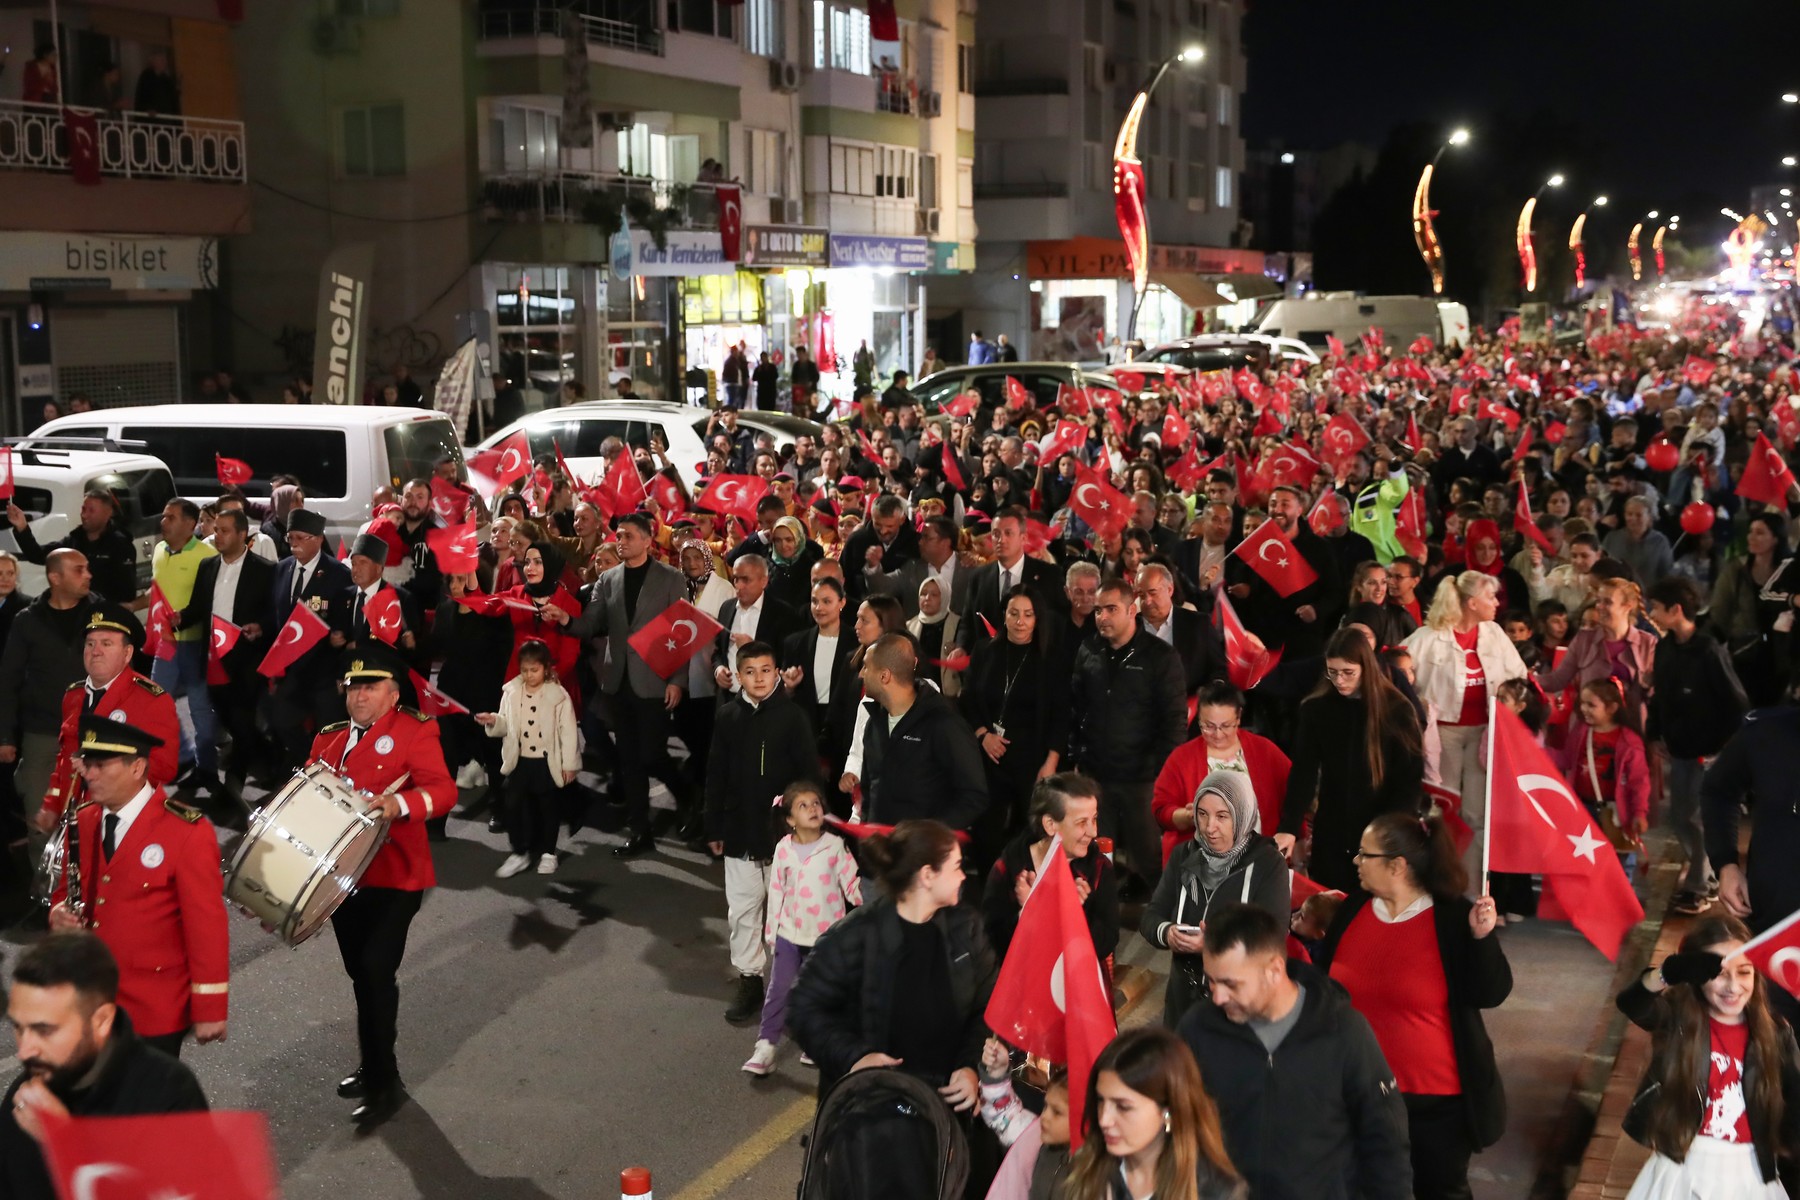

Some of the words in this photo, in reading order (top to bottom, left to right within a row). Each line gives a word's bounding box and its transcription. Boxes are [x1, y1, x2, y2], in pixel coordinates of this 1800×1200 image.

[66, 240, 168, 271] bisiklet
[670, 241, 726, 264] Temizlem
[325, 271, 354, 405] anchi
